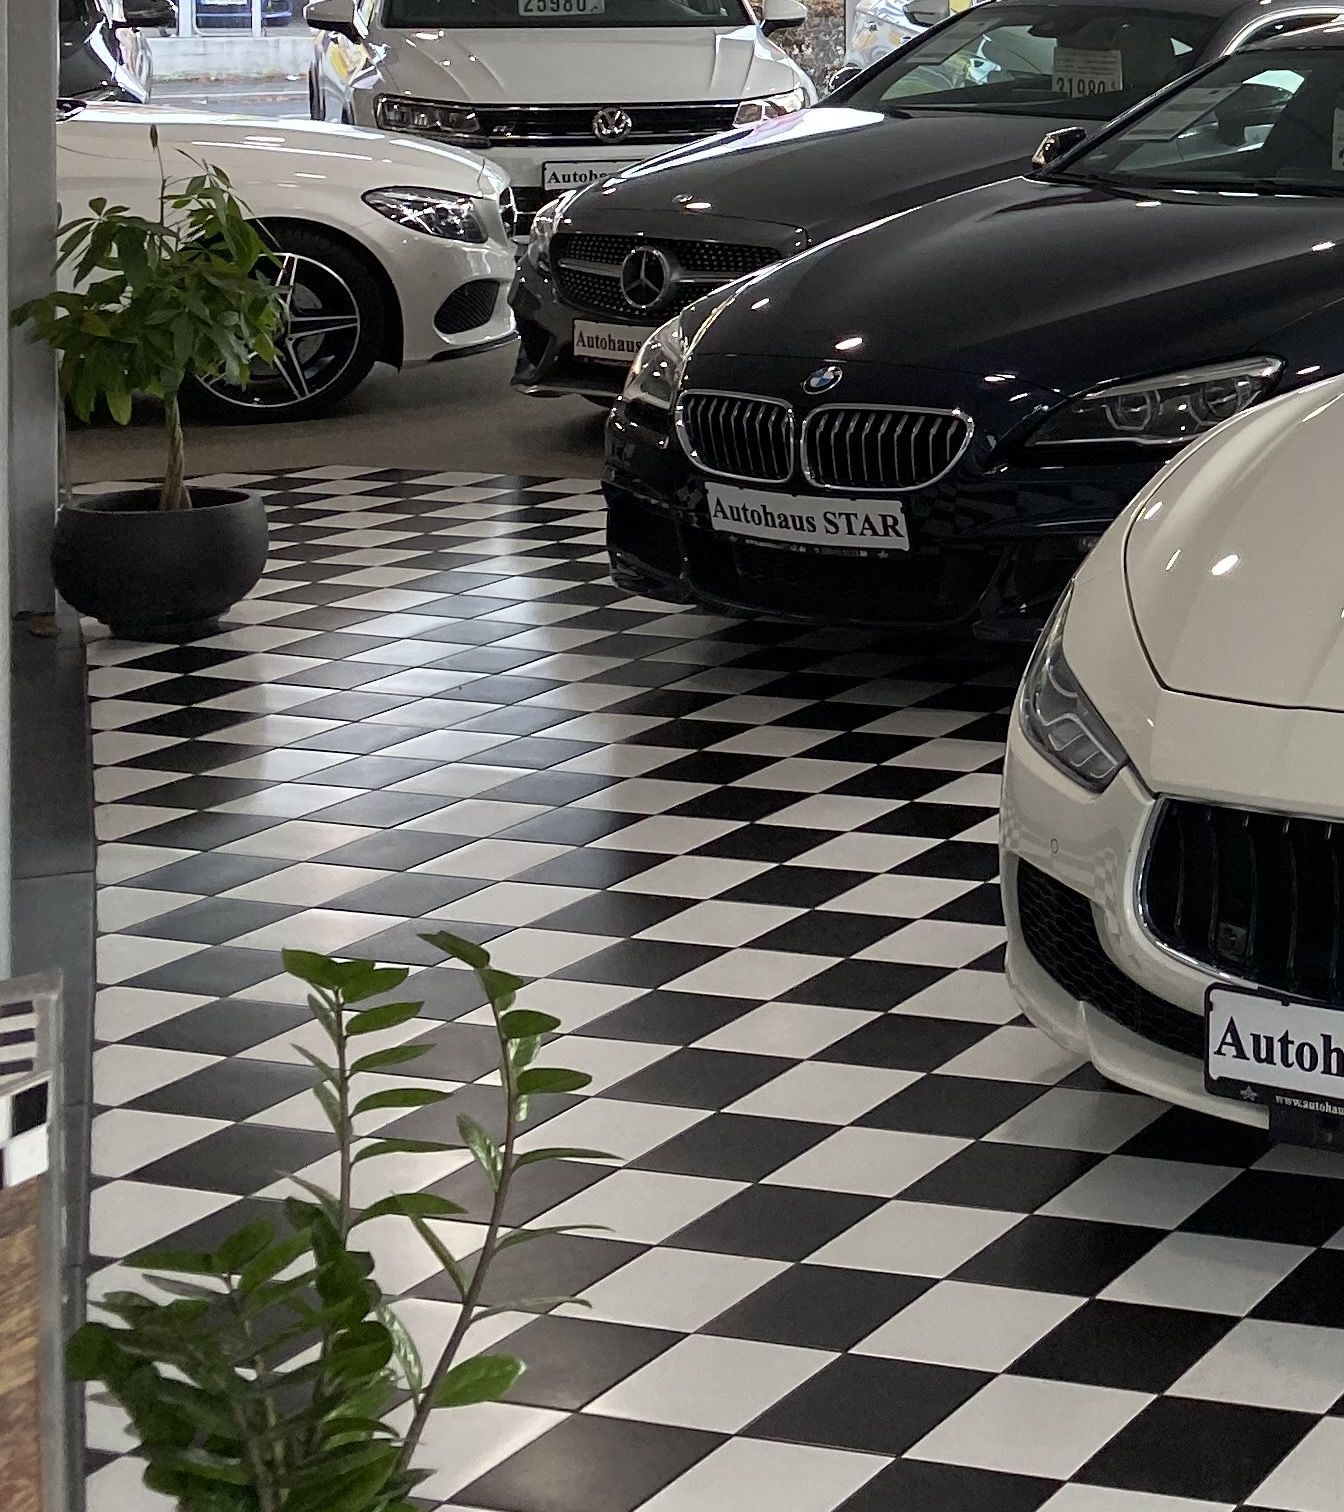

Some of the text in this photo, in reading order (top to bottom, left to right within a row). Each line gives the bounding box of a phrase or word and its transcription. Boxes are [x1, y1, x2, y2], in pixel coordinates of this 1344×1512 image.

[576, 330, 642, 353] Autohaus
[712, 497, 905, 538] Autohaus STAR
